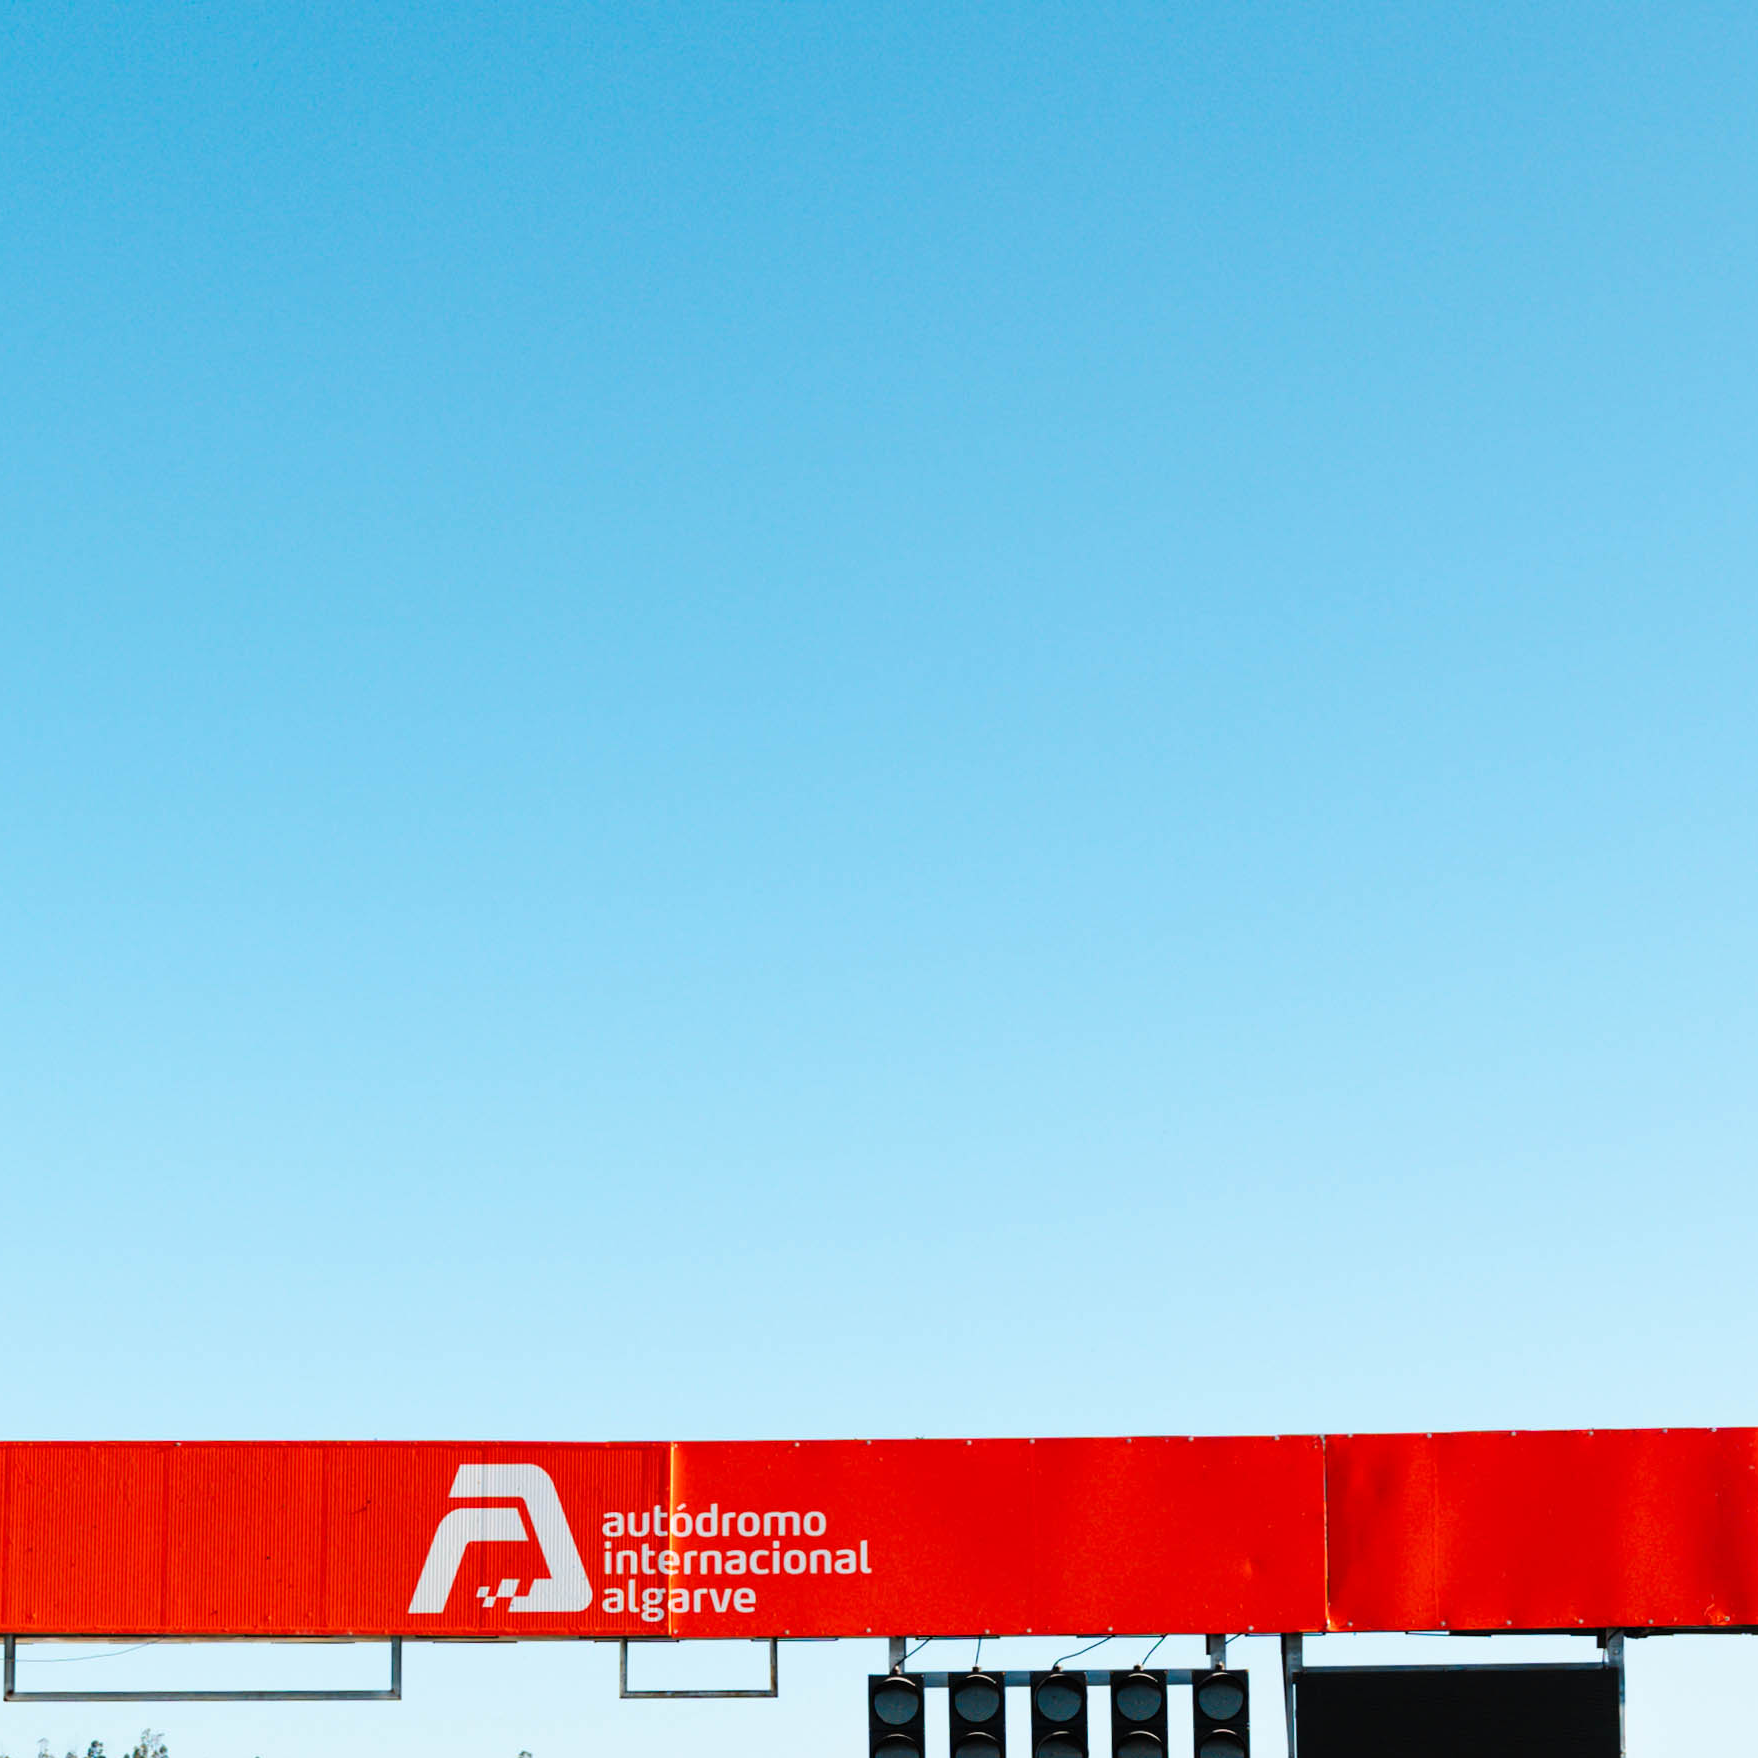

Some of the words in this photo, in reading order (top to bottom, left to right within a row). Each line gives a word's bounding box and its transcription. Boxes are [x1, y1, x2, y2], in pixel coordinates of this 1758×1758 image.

[603, 1503, 827, 1538] autódromo
[604, 1539, 872, 1576] internacional
[602, 1578, 757, 1623] algarve
